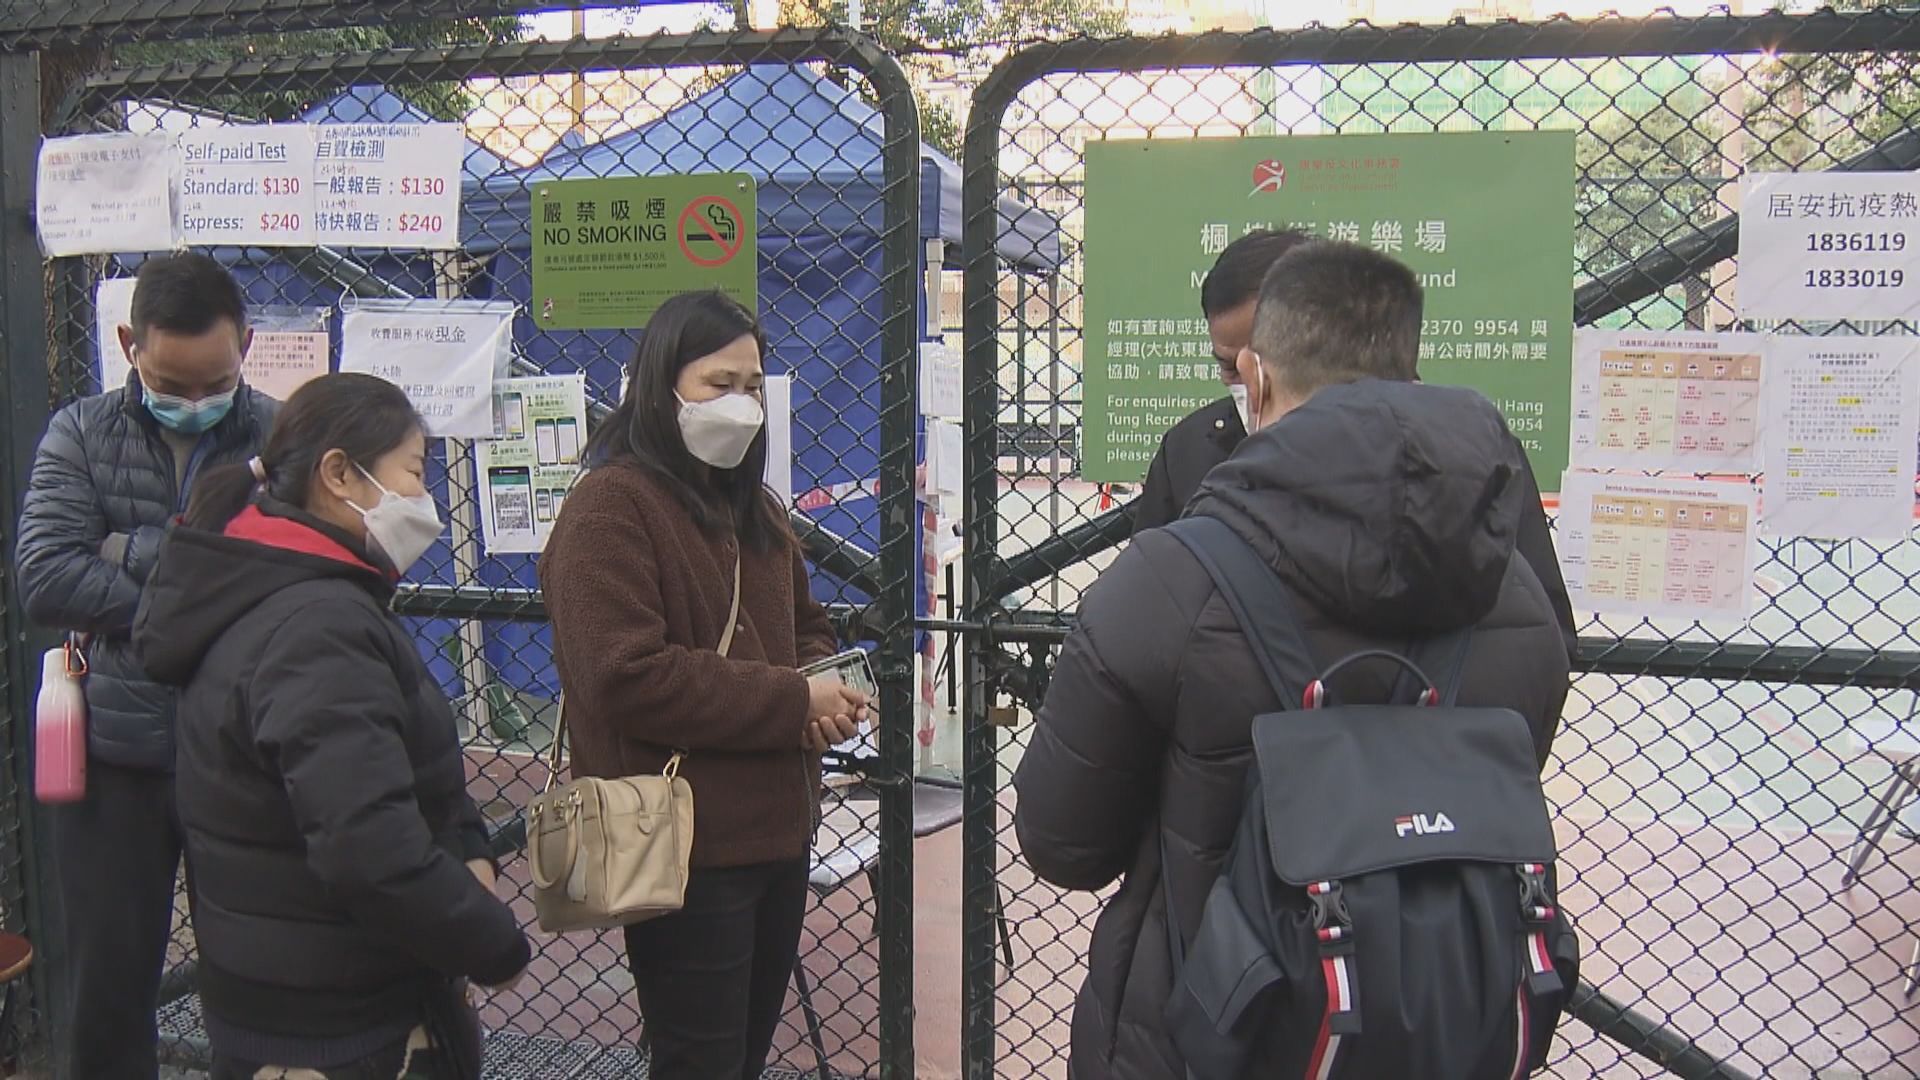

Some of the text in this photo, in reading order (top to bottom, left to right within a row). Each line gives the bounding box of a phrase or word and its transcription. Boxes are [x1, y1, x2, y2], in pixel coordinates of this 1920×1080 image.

[186, 142, 286, 163] Self-paid Test
[317, 140, 384, 158] 自費檢測
[184, 177, 299, 196] Standard: $130
[401, 177, 444, 195] $130
[544, 198, 665, 223] 嚴禁吸煙
[1768, 192, 1918, 218] 居安抗疫熱
[184, 213, 299, 233] Express: $240
[399, 213, 442, 233] $240
[544, 225, 666, 245] NO SMOKING
[1807, 233, 1905, 252] 1836119
[1805, 270, 1904, 288] 1833019
[1421, 320, 1462, 335] 2370
[1474, 320, 1519, 336] 9954
[1531, 320, 1547, 337] 與
[1419, 342, 1547, 360] 辦公時間外需要
[527, 397, 533, 407] 1
[1108, 395, 1129, 407] For
[1133, 395, 1195, 410] enquiries
[1506, 400, 1543, 414] Hang
[1107, 412, 1139, 428] Tung
[1508, 418, 1542, 431] 9954
[1107, 430, 1151, 445] during
[491, 445, 498, 455] 2
[1107, 448, 1150, 463] please
[534, 466, 540, 477] 3
[1394, 812, 1455, 837] FILA
